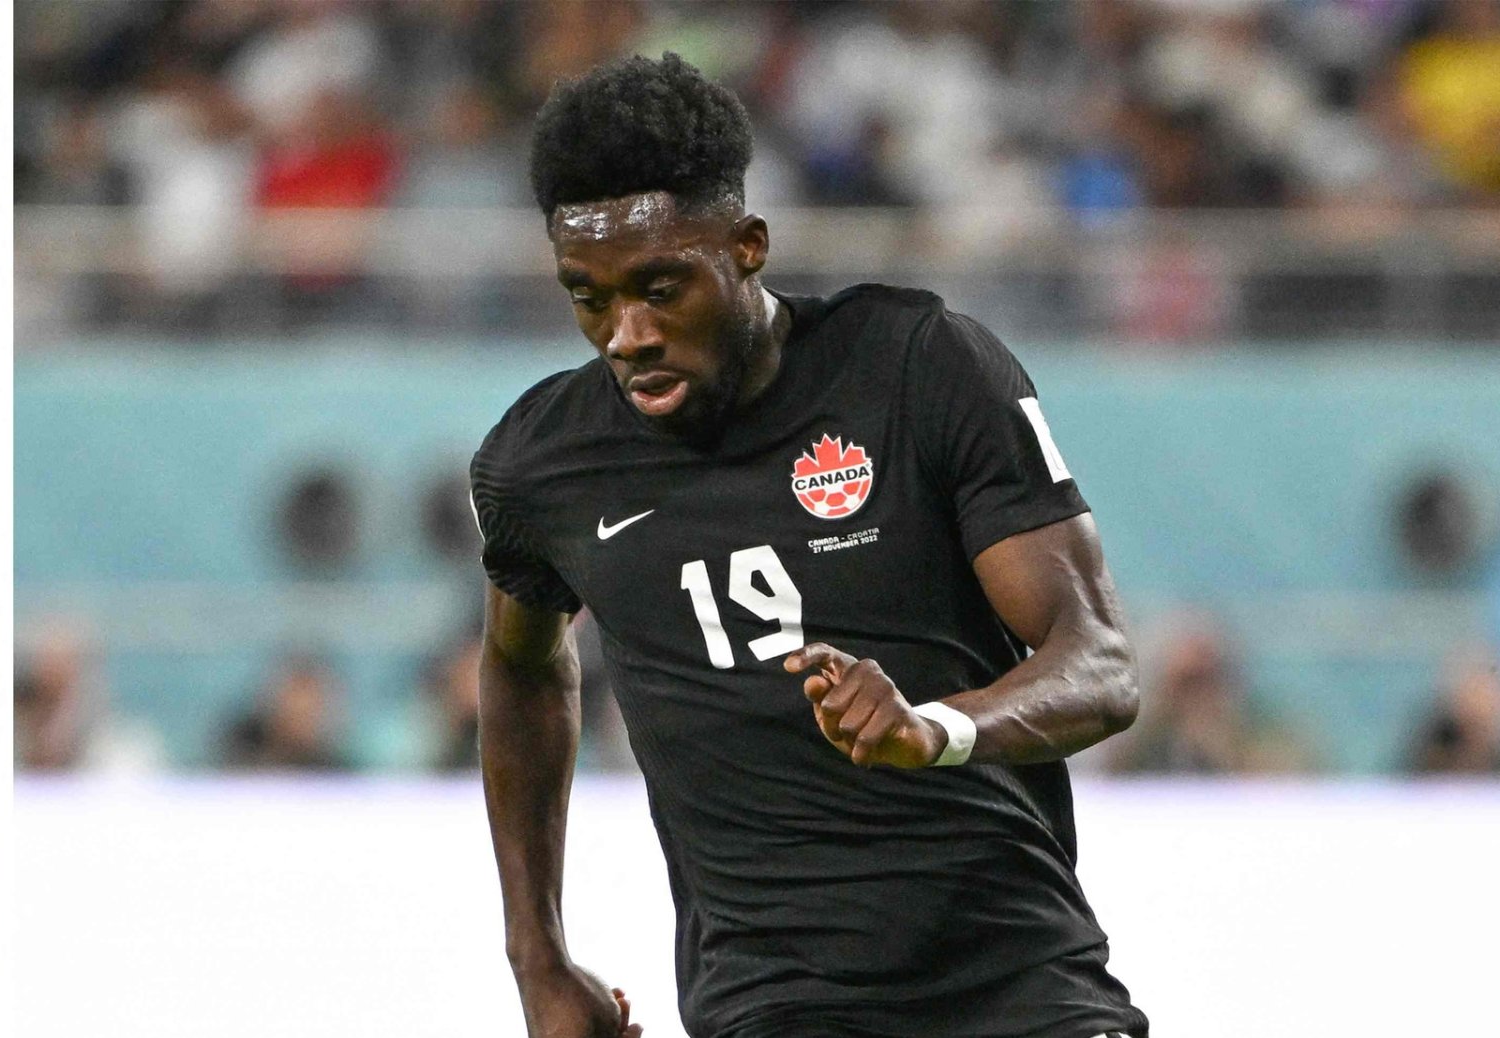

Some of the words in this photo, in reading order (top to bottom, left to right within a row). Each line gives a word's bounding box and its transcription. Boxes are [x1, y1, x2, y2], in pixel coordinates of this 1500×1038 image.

[795, 465, 870, 491] CANADA
[808, 536, 840, 548] CANADA
[847, 527, 880, 540] CROATIA
[823, 539, 860, 552] NOVEMBER
[860, 534, 878, 545] 2022
[681, 545, 804, 669] 19
